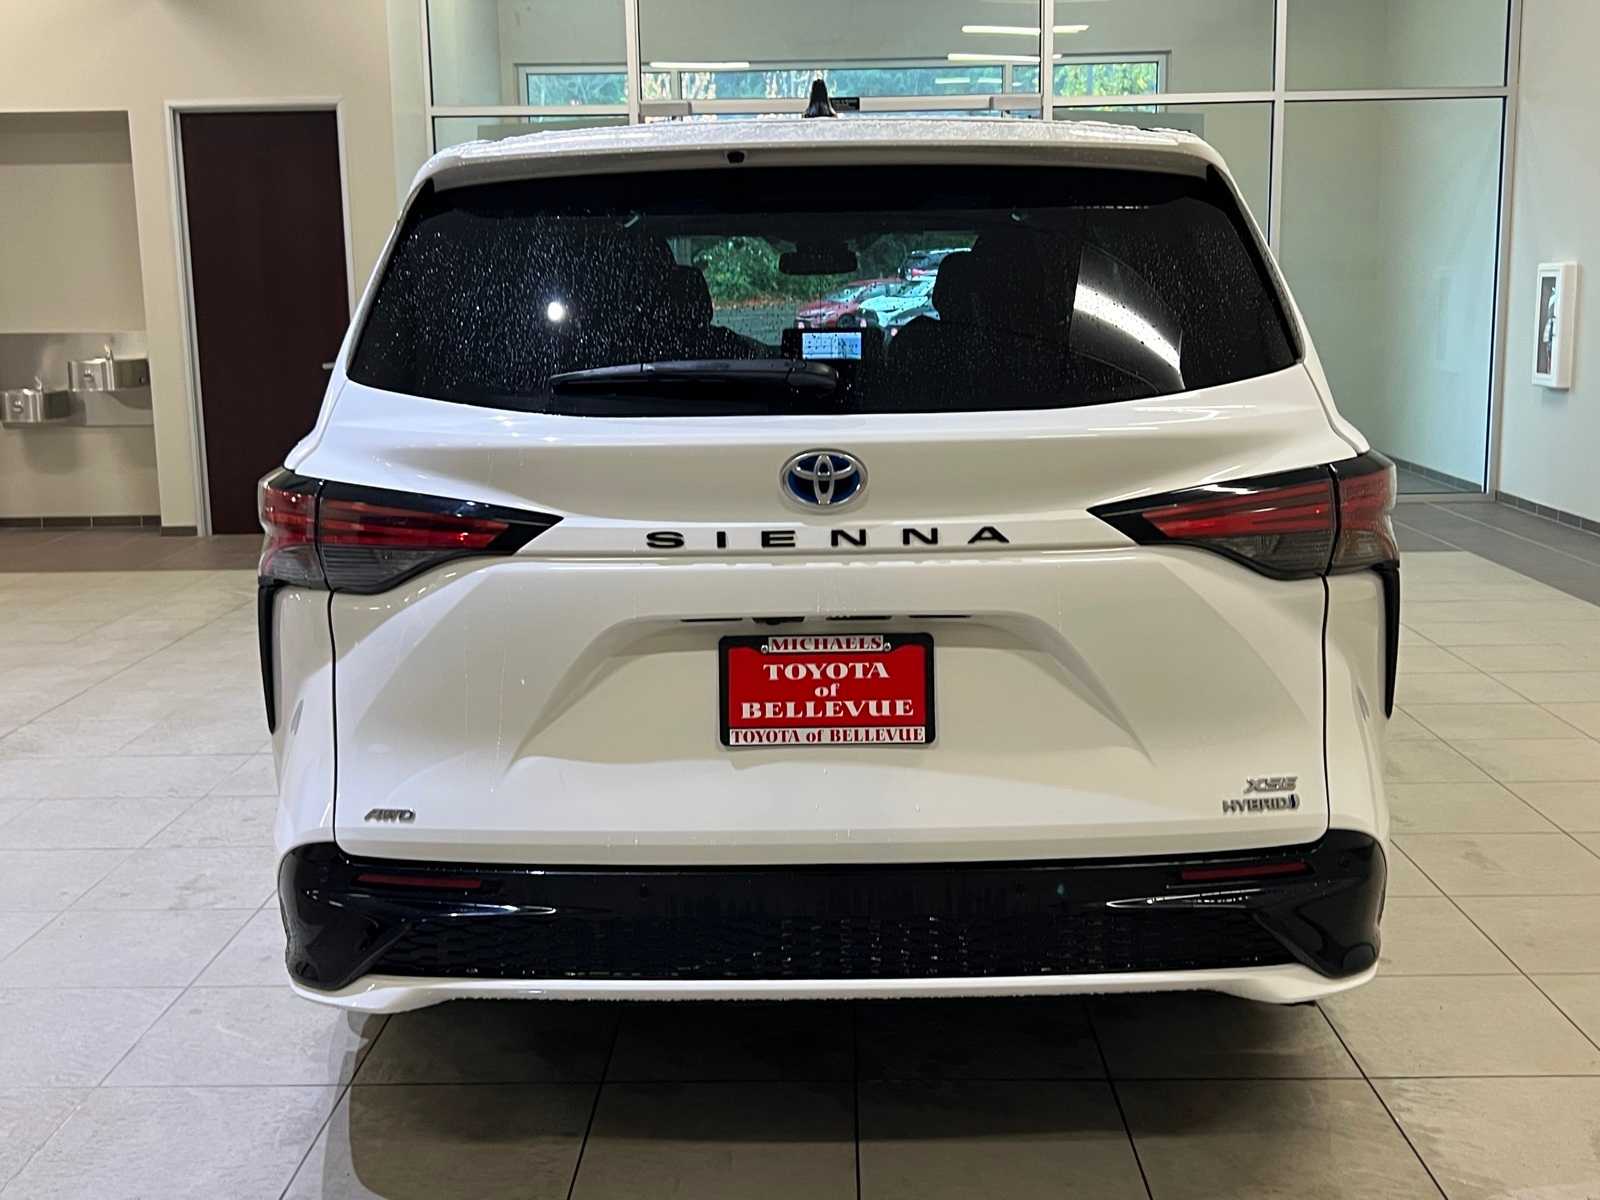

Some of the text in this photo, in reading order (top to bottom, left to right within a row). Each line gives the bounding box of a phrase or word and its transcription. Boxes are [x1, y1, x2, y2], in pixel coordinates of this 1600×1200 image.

[646, 526, 1010, 549] SIENNA
[771, 637, 882, 651] MICHAELS
[763, 662, 890, 680] TOYOTA
[814, 683, 840, 697] of
[741, 699, 914, 719] BELLEVUE
[731, 727, 924, 743] TOYOTA of BELLEVUE
[1243, 776, 1298, 793] XSE
[1222, 796, 1287, 813] HYBRID
[364, 808, 416, 824] AWD
